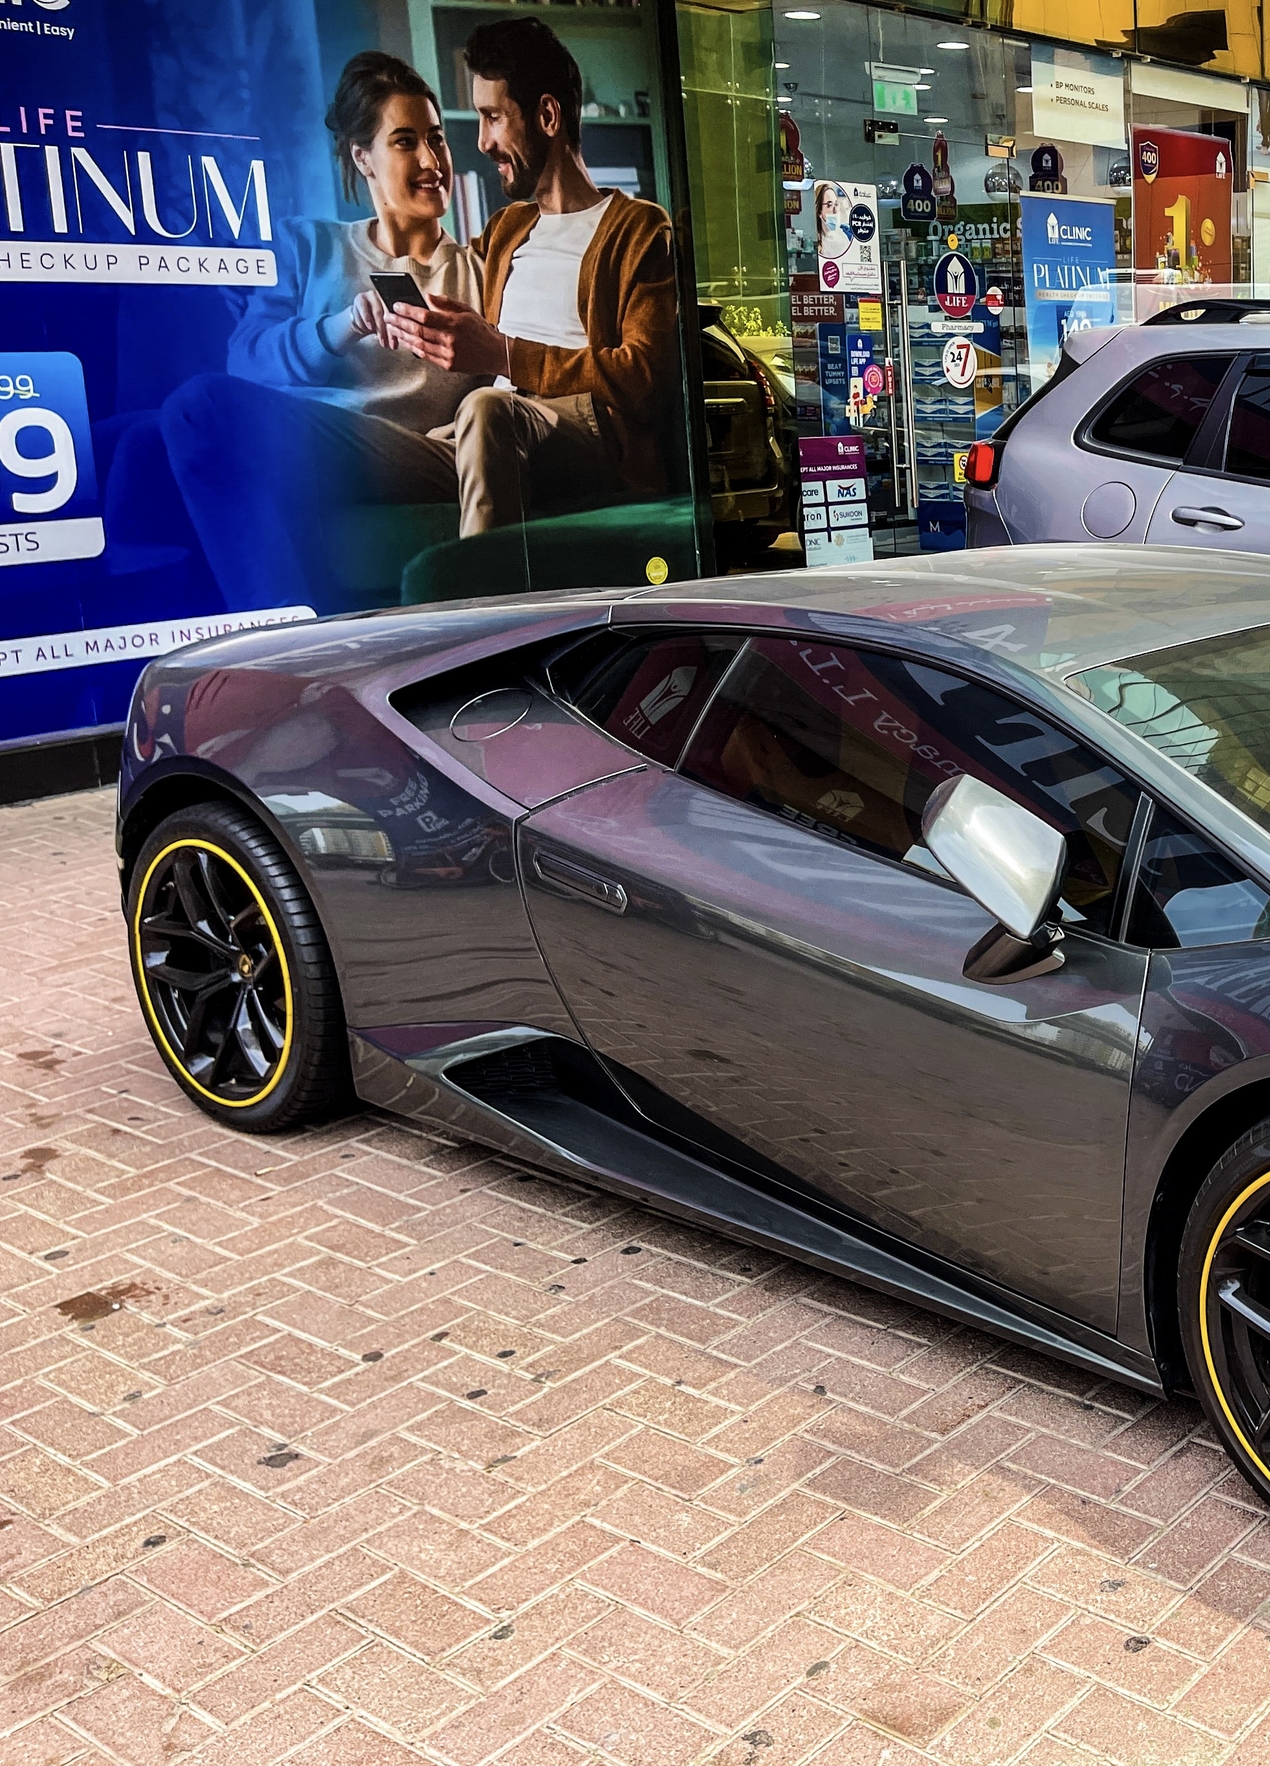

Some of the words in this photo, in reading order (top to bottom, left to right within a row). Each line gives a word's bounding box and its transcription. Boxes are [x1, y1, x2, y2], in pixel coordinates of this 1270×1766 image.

[43, 24, 75, 40] Easy
[1055, 81, 1064, 90] BP
[1064, 83, 1096, 96] MONITORS
[1055, 97, 1088, 109] PERSONAL
[1087, 101, 1109, 112] SCALES
[1142, 151, 1157, 164] 400
[1034, 180, 1062, 194] 400
[906, 199, 932, 213] 400
[928, 217, 1010, 243] Organic
[1060, 225, 1092, 241] CLINIC
[138, 254, 267, 275] PACKAGE
[1062, 256, 1080, 264] LIFE
[1032, 263, 1110, 290] PLATINUM
[803, 295, 837, 306] BETTER,
[1038, 291, 1059, 299] HEALTH
[944, 296, 969, 308] LIFE
[803, 307, 837, 317] BETTER.
[941, 323, 975, 332] Pharmacy
[850, 350, 871, 358] DOWNLOAD
[950, 350, 963, 363] 24
[956, 343, 971, 377] 7
[827, 363, 842, 371] BEAT
[824, 371, 845, 379] TUMMY
[844, 445, 860, 453] CLINIC
[0, 406, 78, 514] 9
[817, 464, 832, 472] MAJOR
[832, 463, 858, 471] INSURANCES
[837, 487, 857, 498] NAS
[929, 521, 941, 533] M
[36, 643, 74, 661] ALL
[85, 633, 160, 656] MAJOR
